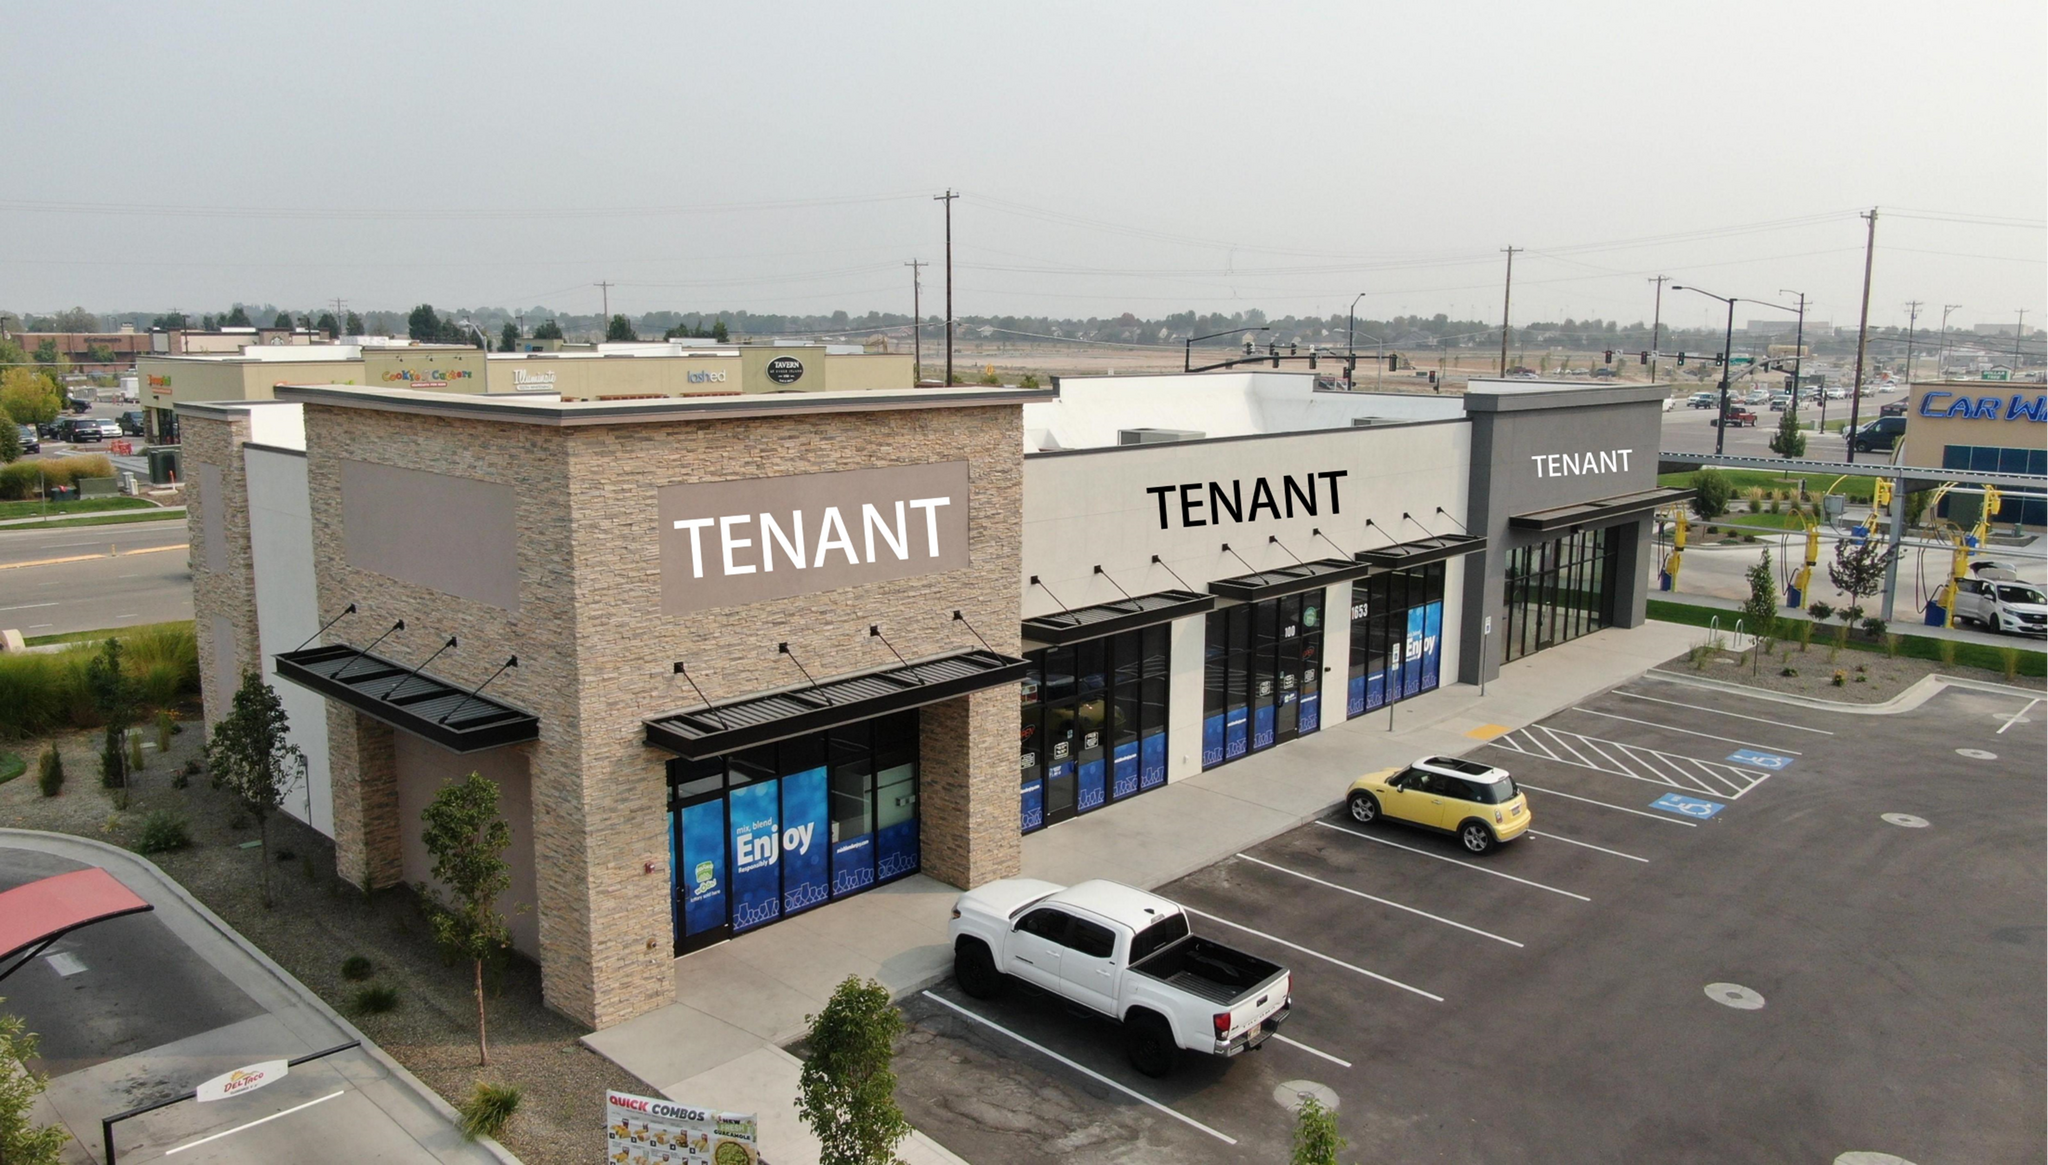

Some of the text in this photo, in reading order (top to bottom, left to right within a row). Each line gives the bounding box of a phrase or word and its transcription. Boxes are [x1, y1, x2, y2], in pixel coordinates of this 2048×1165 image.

[774, 361, 799, 369] TAVERN
[382, 368, 421, 382] Cookie
[513, 369, 556, 385] Illuminate
[687, 370, 726, 383] lashed
[1919, 391, 2001, 419] CAR
[1532, 450, 1633, 478] TENANT
[1147, 471, 1347, 530] TENANT
[673, 496, 950, 578] TENANT
[1352, 603, 1368, 620] 1653
[1285, 625, 1295, 638] 100
[1406, 633, 1435, 659] Enjoy
[752, 816, 773, 830] blend
[737, 821, 815, 866] Enjoy
[738, 858, 769, 874] Responsibly
[224, 1081, 243, 1093] DEL
[243, 1072, 264, 1086] TACO
[609, 1095, 706, 1122] QUICK COMBOS
[713, 1129, 751, 1141] GUACAMOLE
[720, 1124, 745, 1133] FRESH
